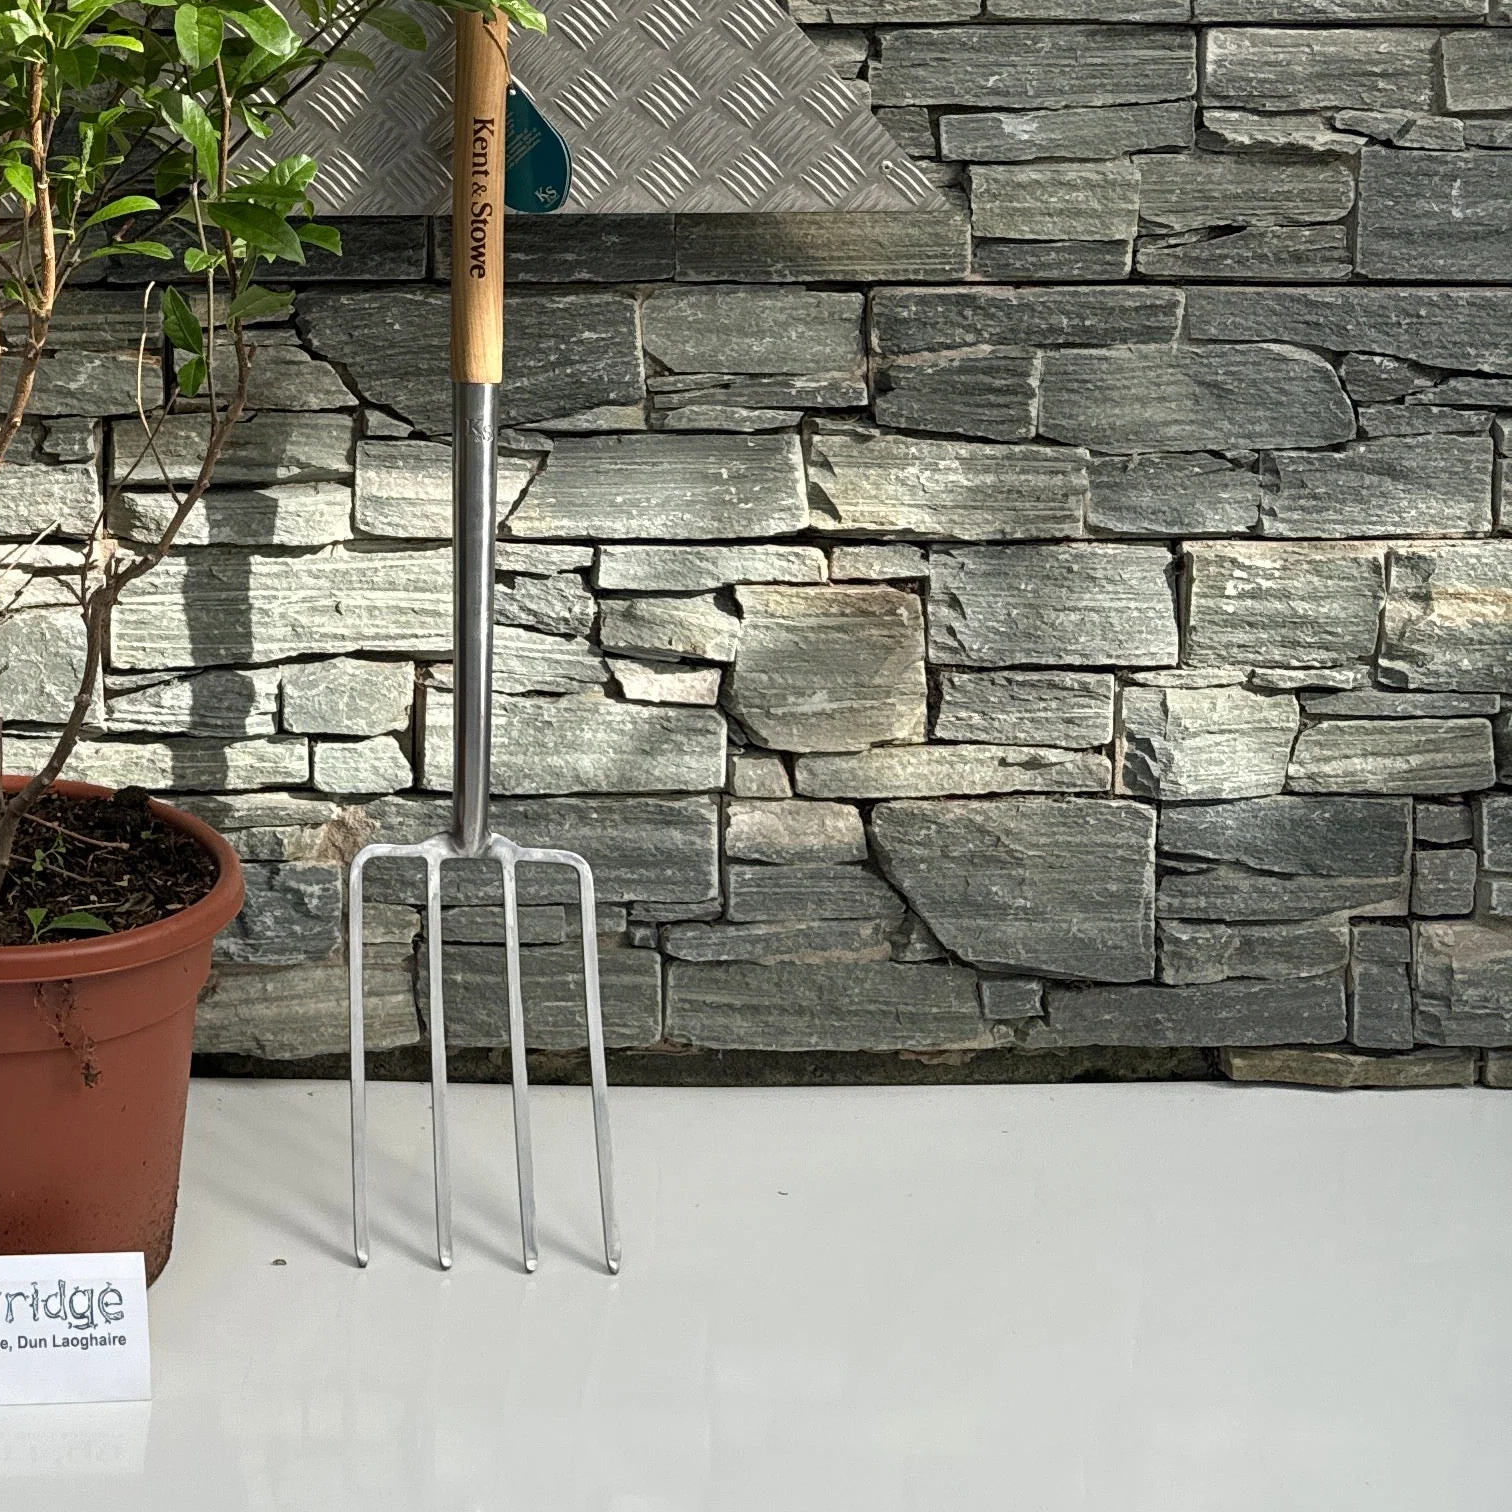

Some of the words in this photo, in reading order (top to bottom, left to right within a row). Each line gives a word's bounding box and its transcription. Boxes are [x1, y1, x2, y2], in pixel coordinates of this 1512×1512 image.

[472, 117, 494, 178] Kent
[471, 182, 487, 198] &
[469, 201, 493, 280] Stowe
[17, 1334, 48, 1350] Dun
[52, 1331, 127, 1350] Laoghaire
